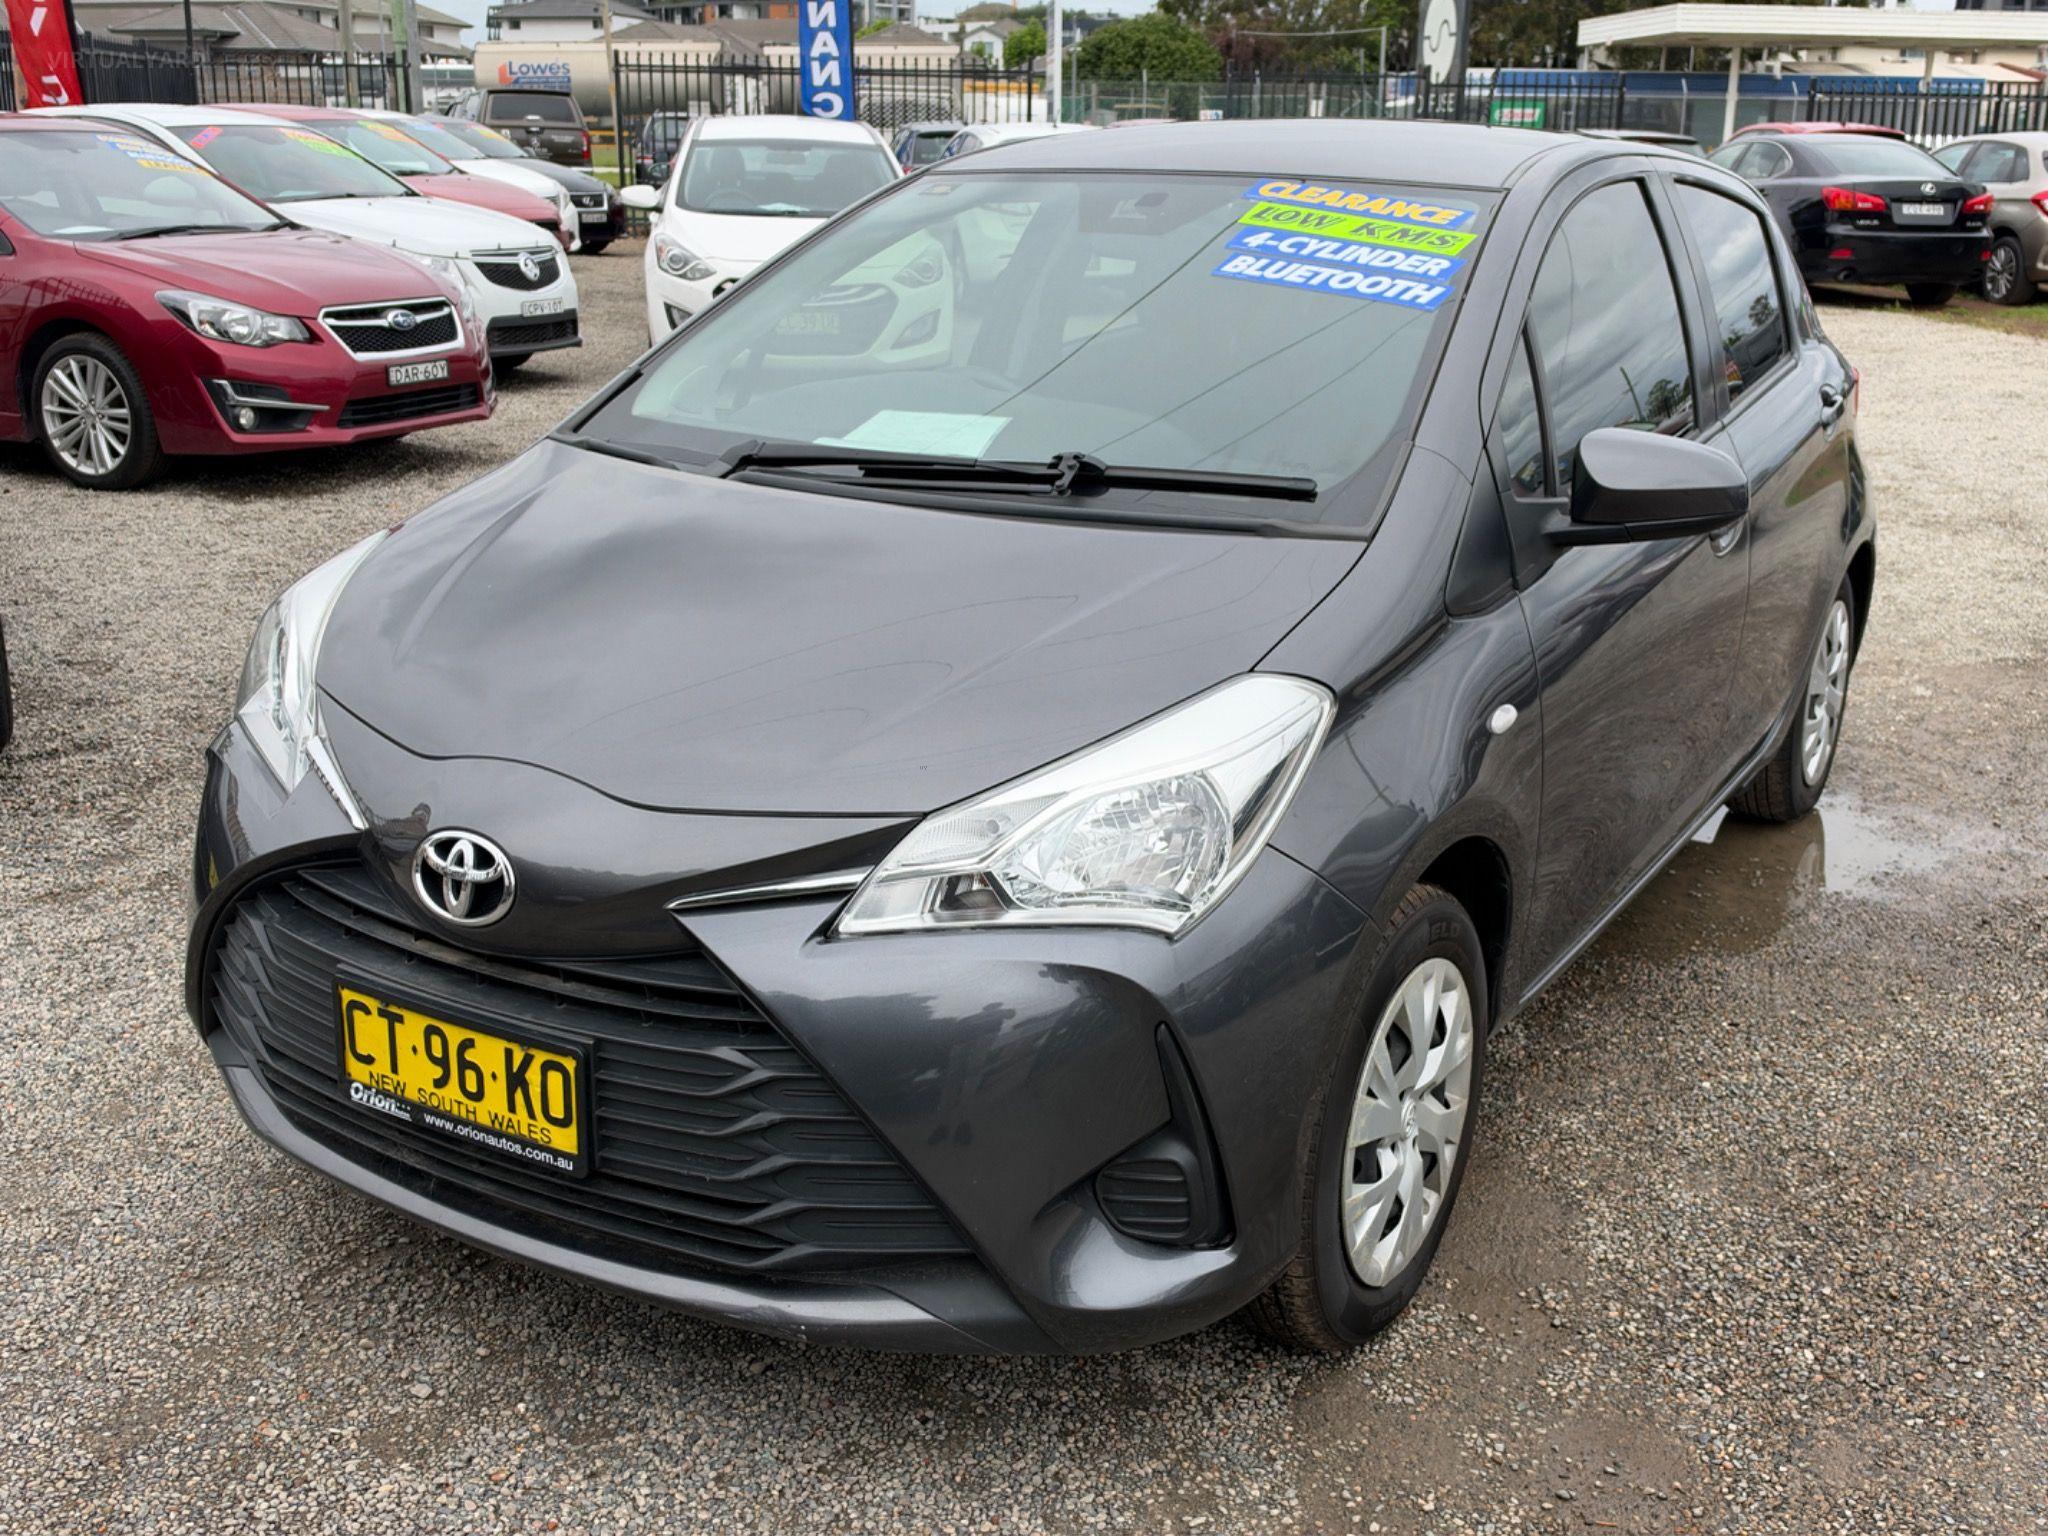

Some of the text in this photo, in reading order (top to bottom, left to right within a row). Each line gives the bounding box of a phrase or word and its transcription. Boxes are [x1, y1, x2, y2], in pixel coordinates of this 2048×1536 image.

[508, 61, 571, 76] Lowes
[1258, 181, 1463, 225] CLEARANCE
[1250, 206, 1463, 249] LOW KMS
[1243, 231, 1452, 277] 4-CYLINDER
[1220, 255, 1446, 304] BLUETOOTH
[349, 1081, 396, 1113] Orion
[369, 1070, 552, 1144] NEW SOUTH WALES
[424, 1111, 573, 1171] www.orionautos.com.au
